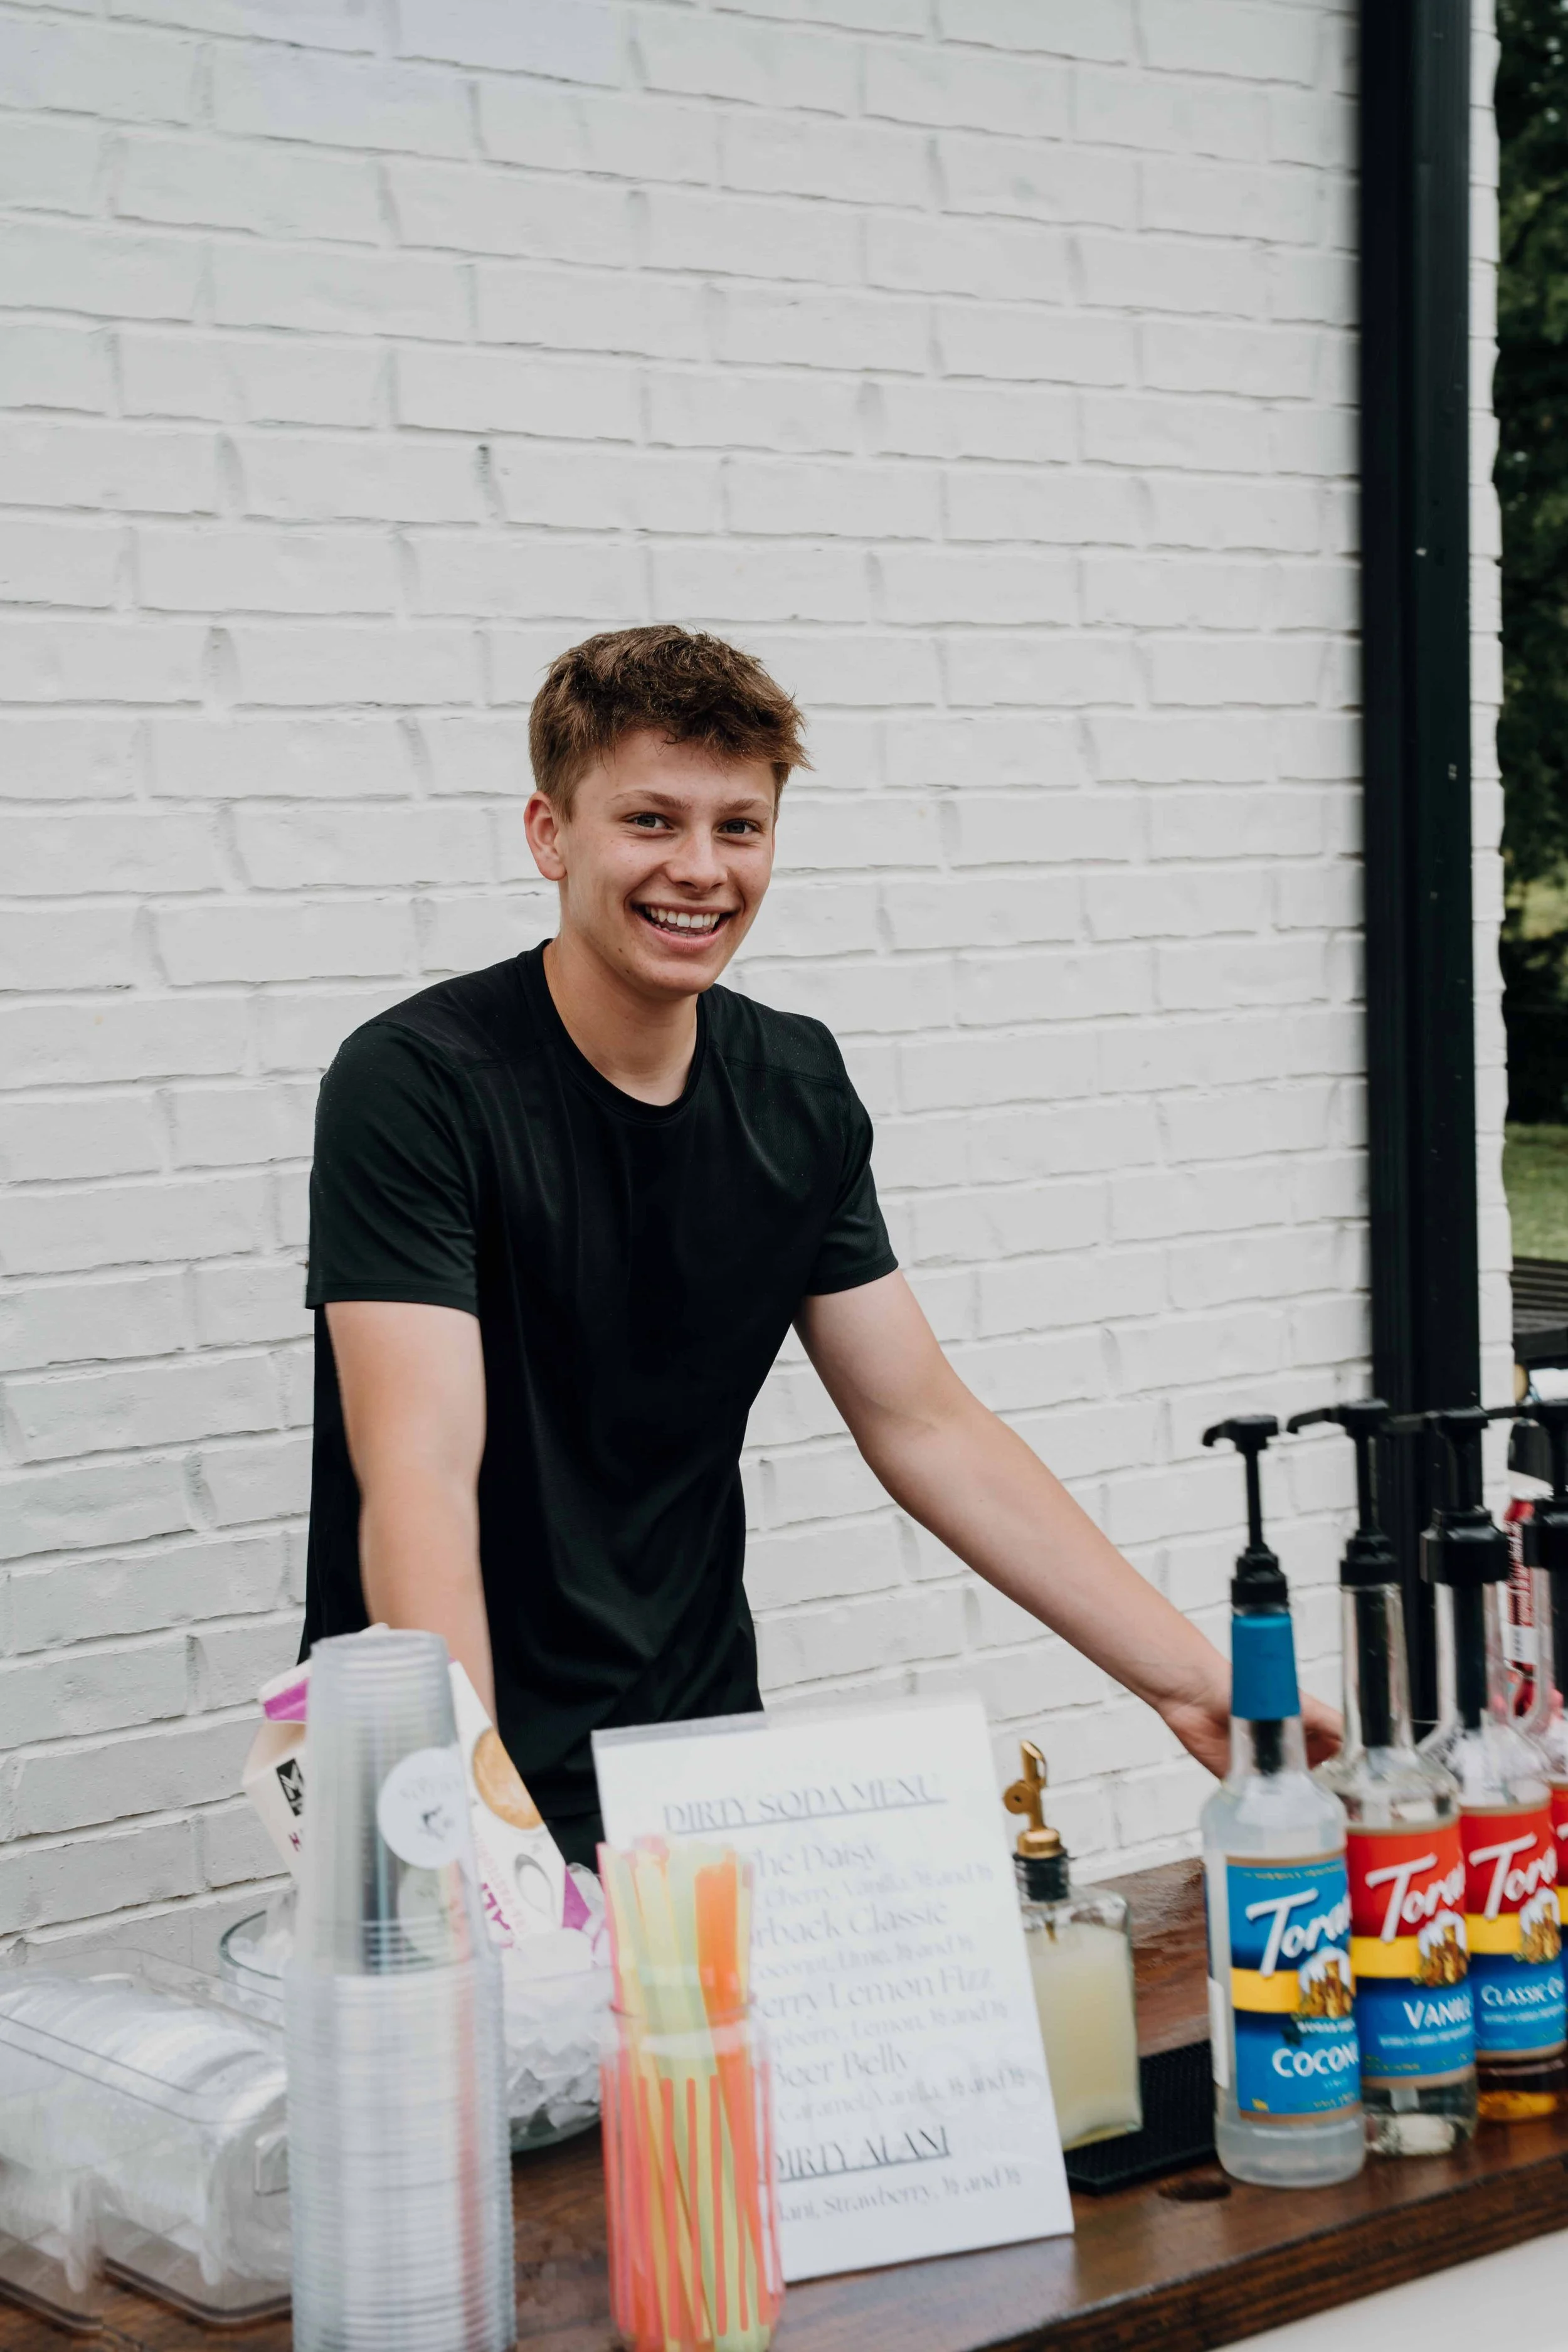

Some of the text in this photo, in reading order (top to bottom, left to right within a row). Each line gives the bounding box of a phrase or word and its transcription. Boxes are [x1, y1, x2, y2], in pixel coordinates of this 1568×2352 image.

[662, 1772, 941, 1831] DIRTY SODA MENU
[754, 1842, 880, 1878] he Daisy
[756, 1899, 948, 1949] rback Classic
[761, 1992, 819, 2020] erry
[829, 1975, 935, 2009] Lemon
[842, 2041, 910, 2080] Belly
